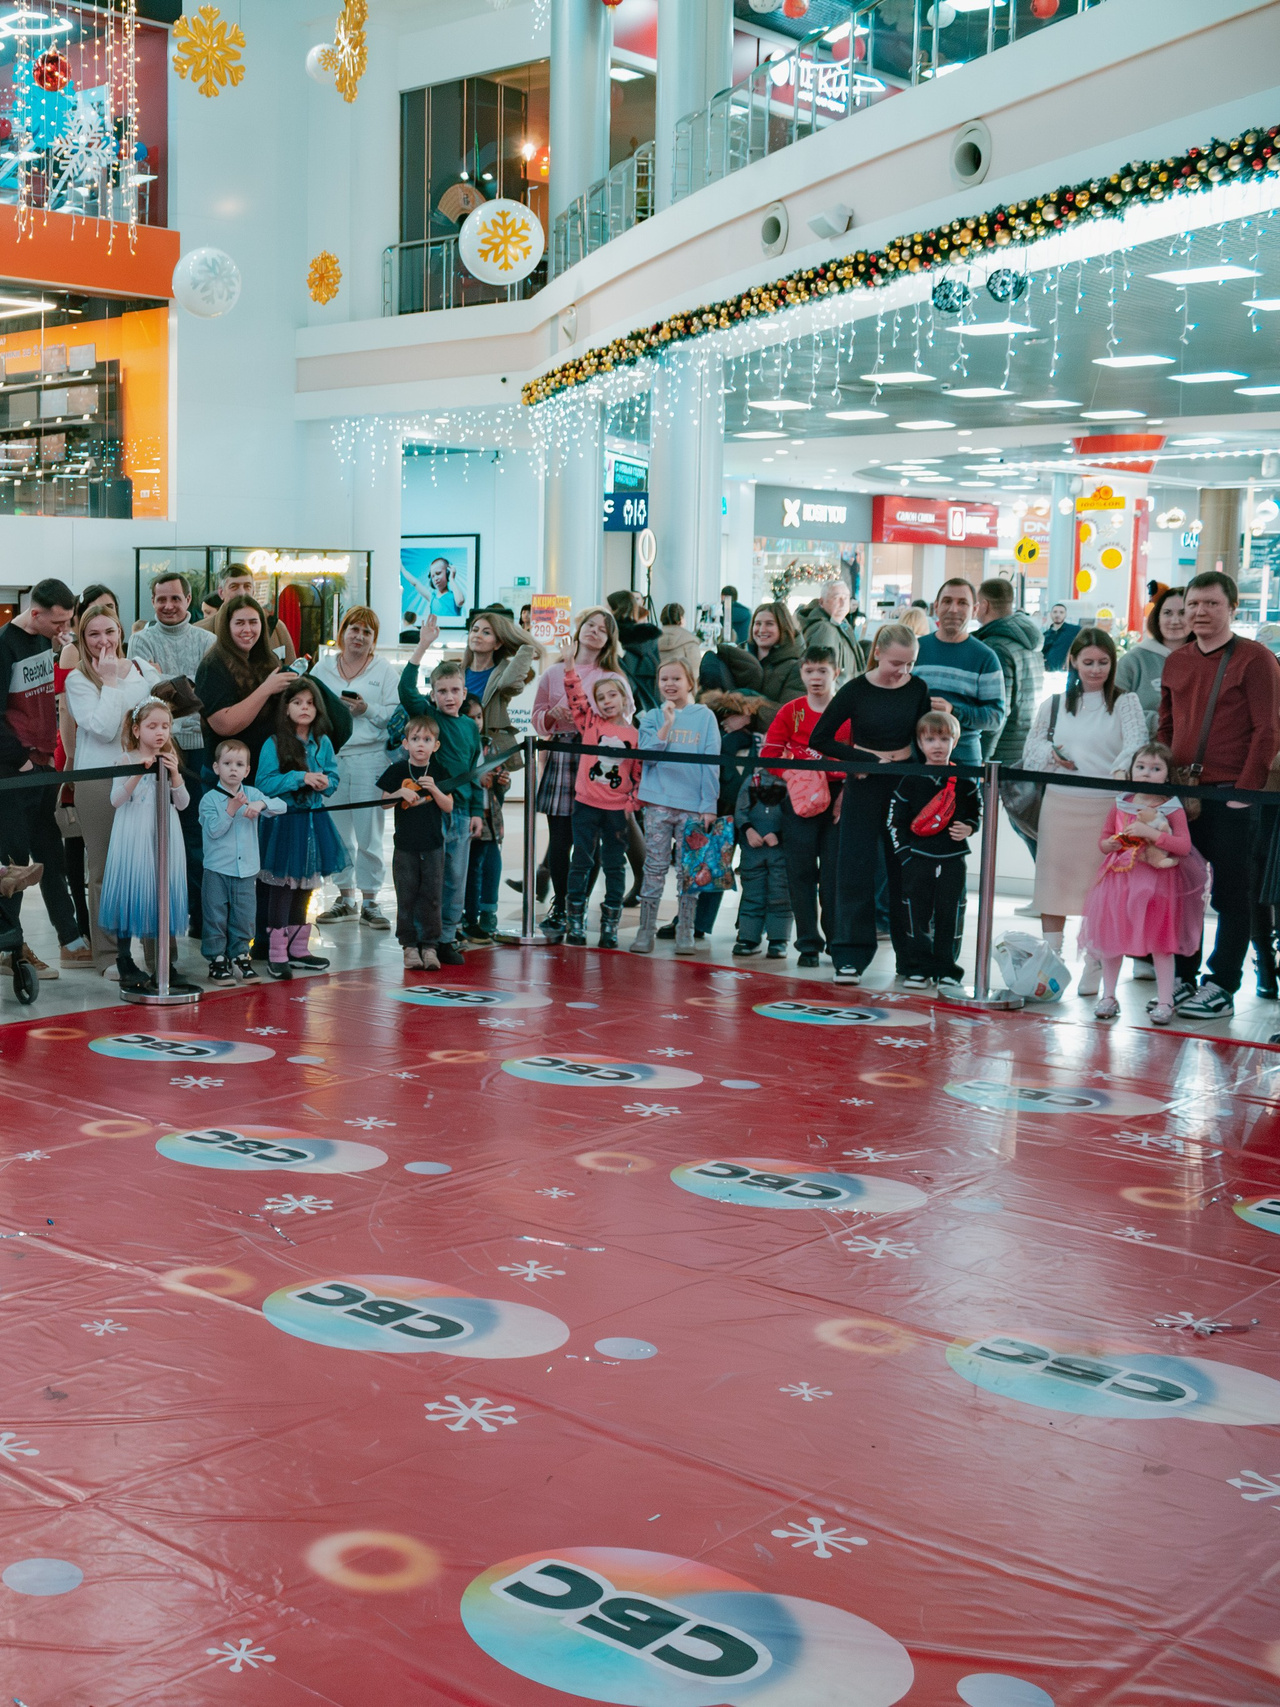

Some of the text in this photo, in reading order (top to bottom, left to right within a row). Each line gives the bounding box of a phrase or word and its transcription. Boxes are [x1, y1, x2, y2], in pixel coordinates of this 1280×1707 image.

[1024, 521, 1050, 533] DN
[534, 624, 551, 637] 299
[23, 660, 49, 684] Reebok
[184, 1130, 309, 1163] СБС
[694, 1163, 843, 1200] СБС
[296, 1284, 465, 1339] СБС
[502, 1564, 759, 1678] СБС
